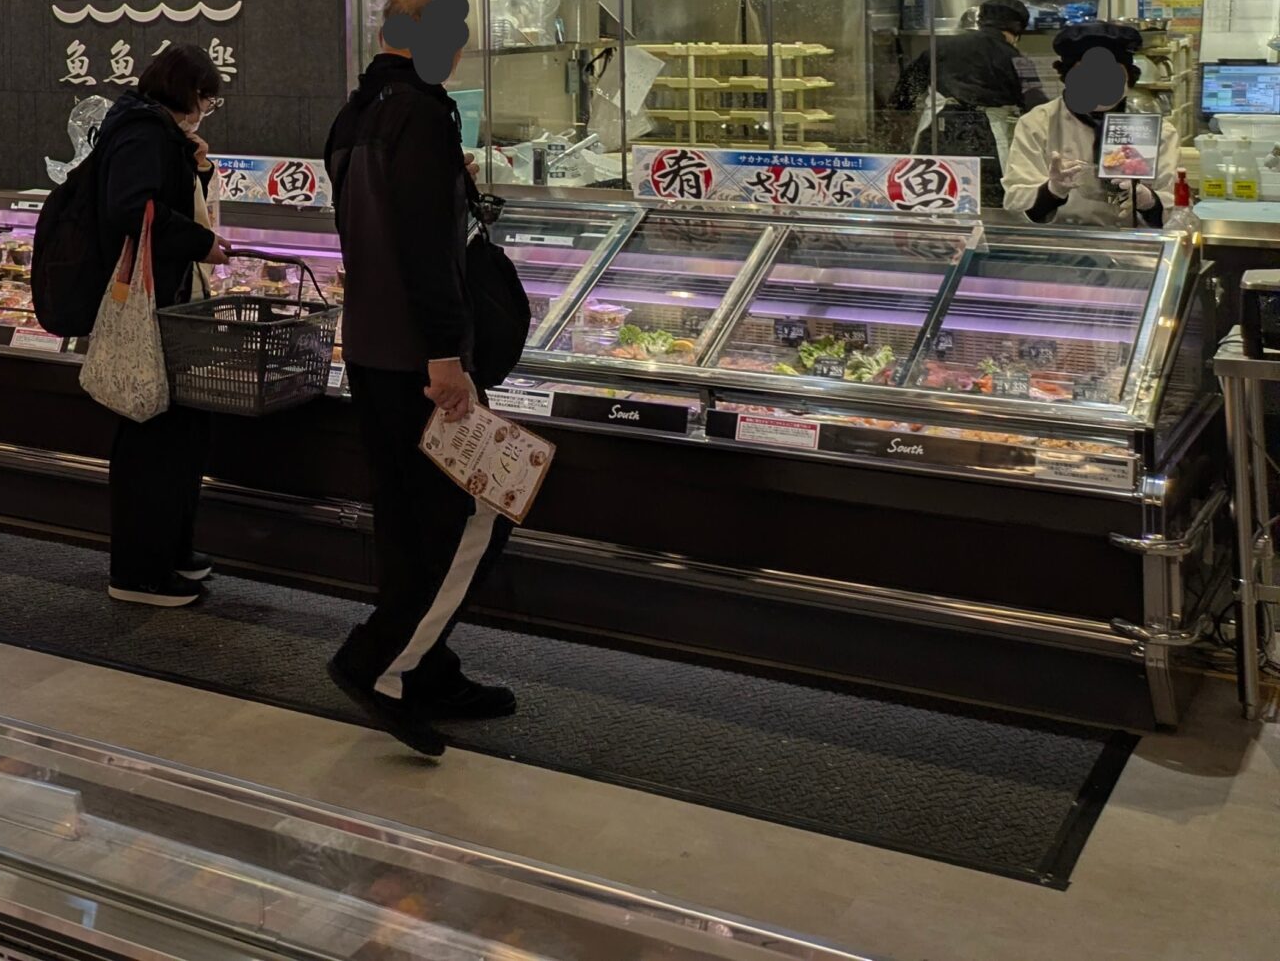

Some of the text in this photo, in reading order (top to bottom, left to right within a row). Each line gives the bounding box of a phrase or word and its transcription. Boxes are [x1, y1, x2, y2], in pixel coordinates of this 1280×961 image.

[58, 39, 238, 86] 魚魚楽
[273, 160, 314, 205] 魚
[746, 169, 857, 204] さかな
[896, 157, 956, 212] 魚
[609, 404, 641, 421] South
[457, 422, 487, 467] GOURMET
[886, 438, 924, 456] South
